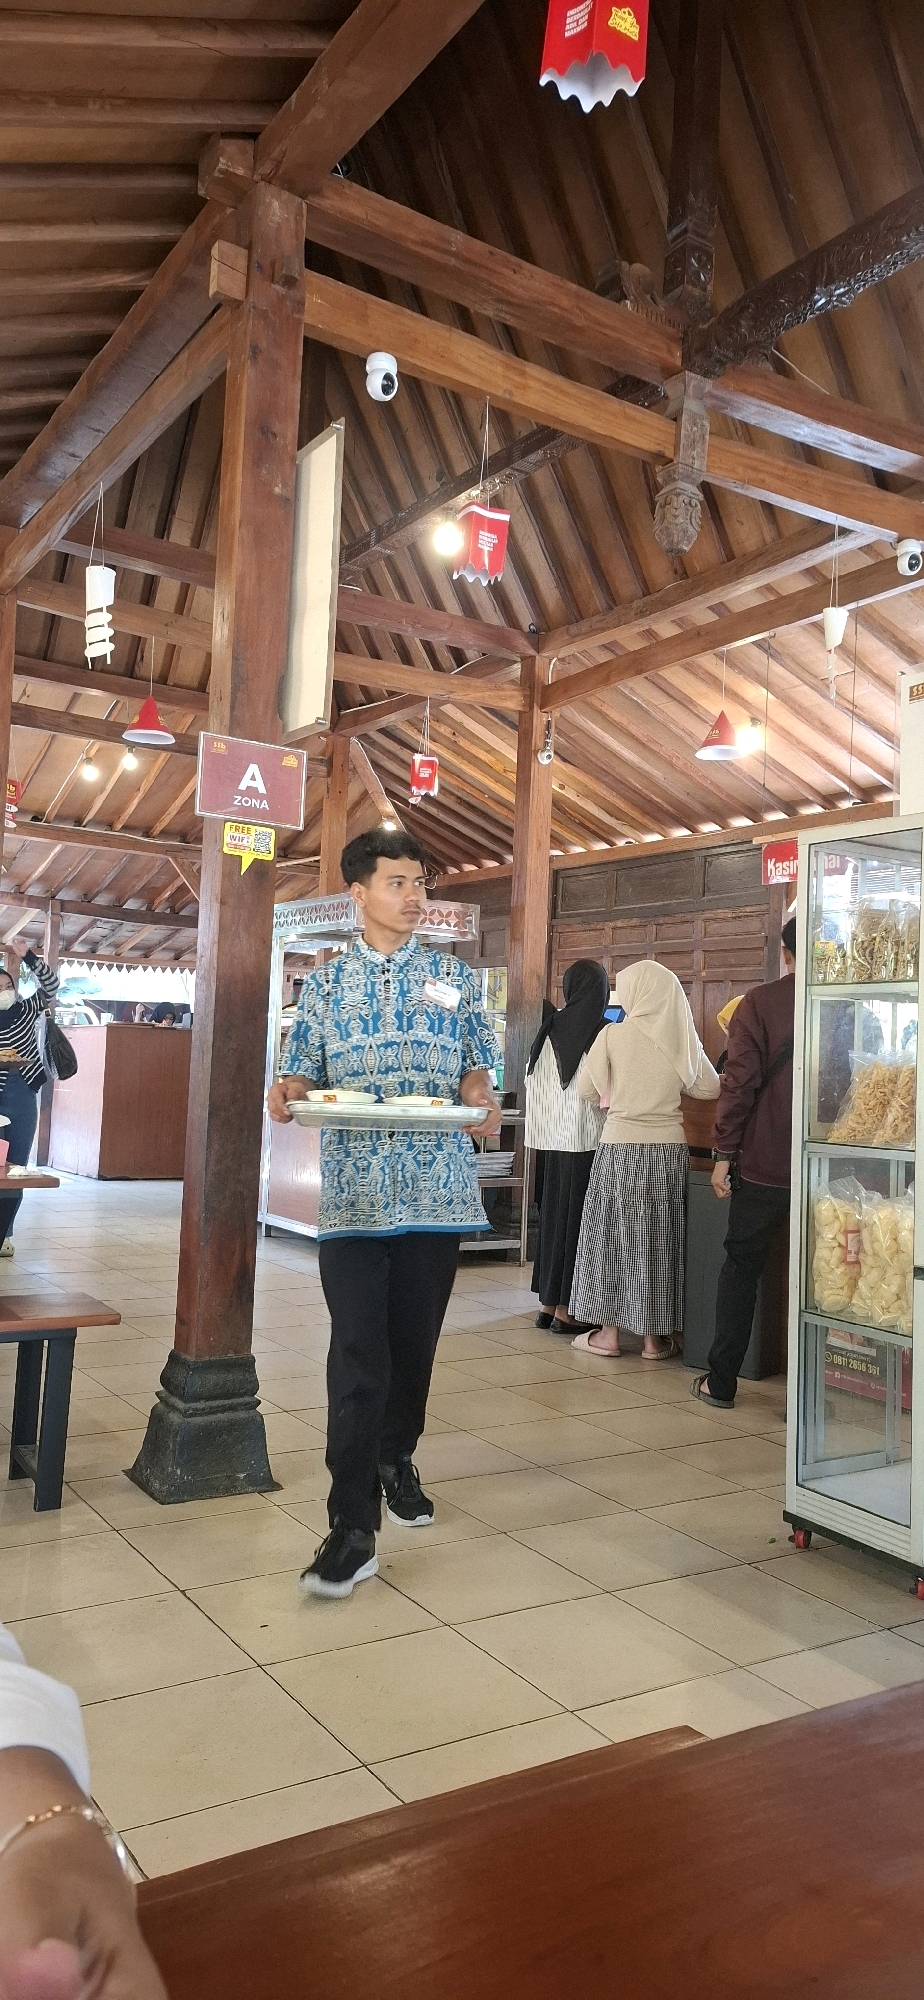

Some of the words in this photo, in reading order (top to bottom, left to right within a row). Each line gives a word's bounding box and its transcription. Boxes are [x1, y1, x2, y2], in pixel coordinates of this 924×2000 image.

[238, 763, 267, 795] A
[233, 795, 269, 811] ZONA
[229, 824, 252, 835] FREE
